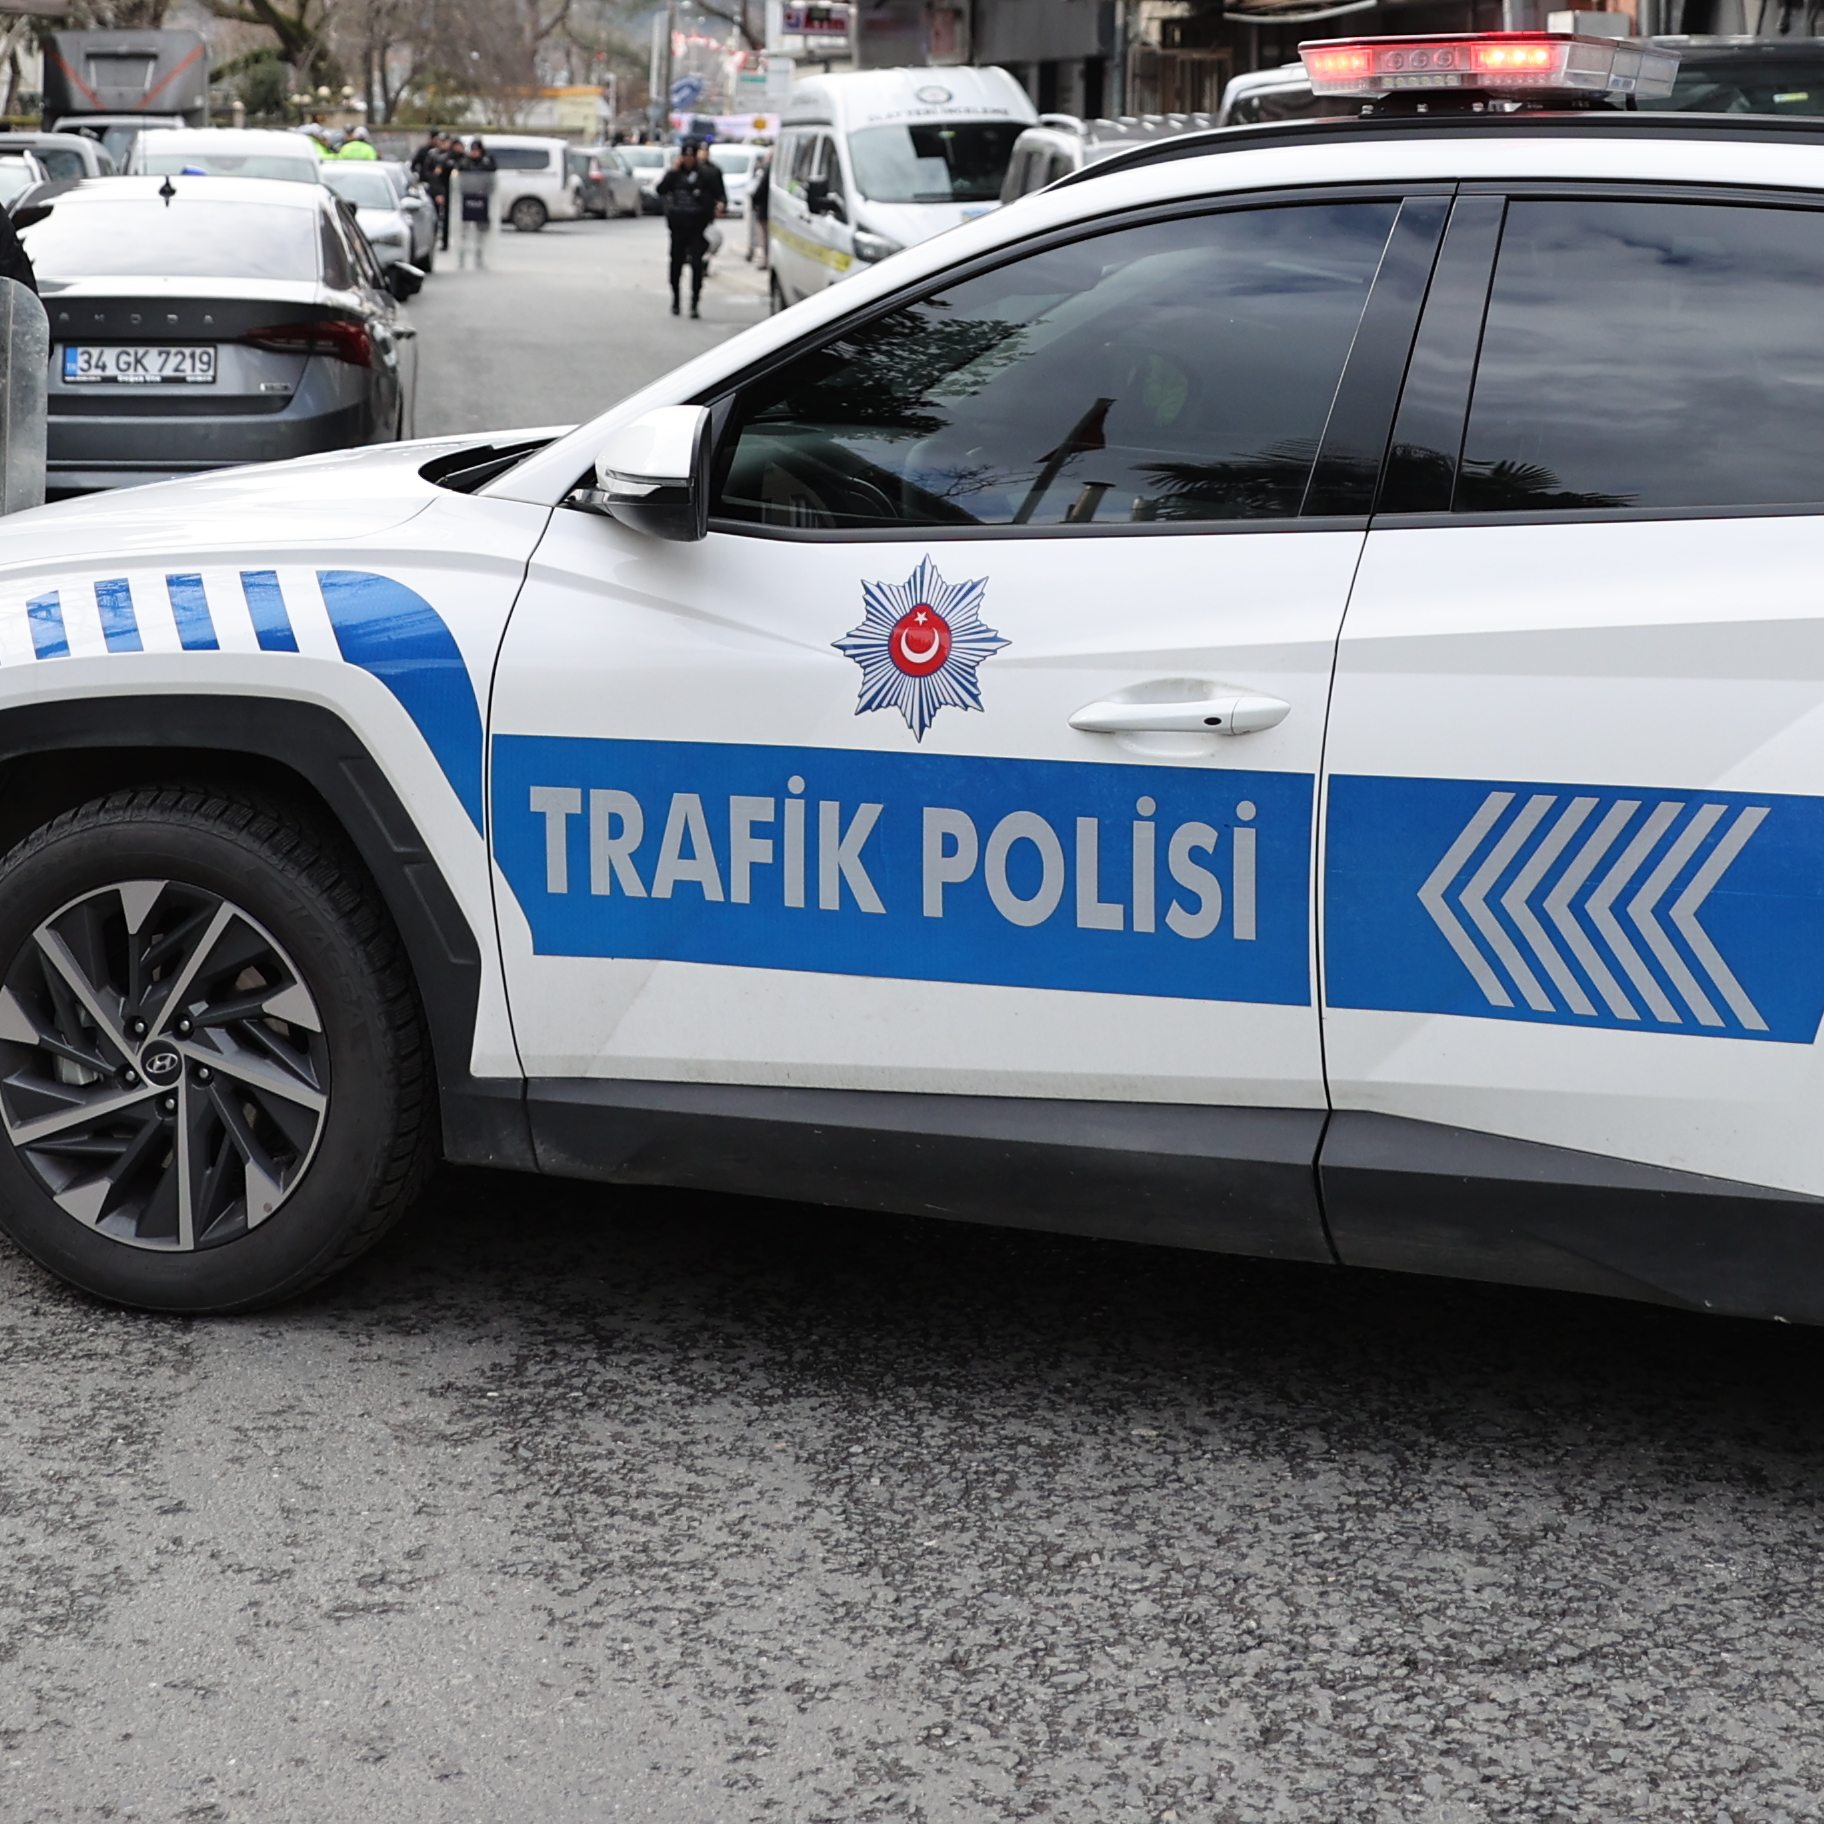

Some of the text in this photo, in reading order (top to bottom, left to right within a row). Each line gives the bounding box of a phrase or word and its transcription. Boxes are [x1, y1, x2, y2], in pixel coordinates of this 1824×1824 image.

[78, 348, 108, 373] 34
[115, 348, 149, 373] GK
[157, 348, 212, 373] 7219
[529, 774, 1257, 941] TRAFİK POLİSİ
